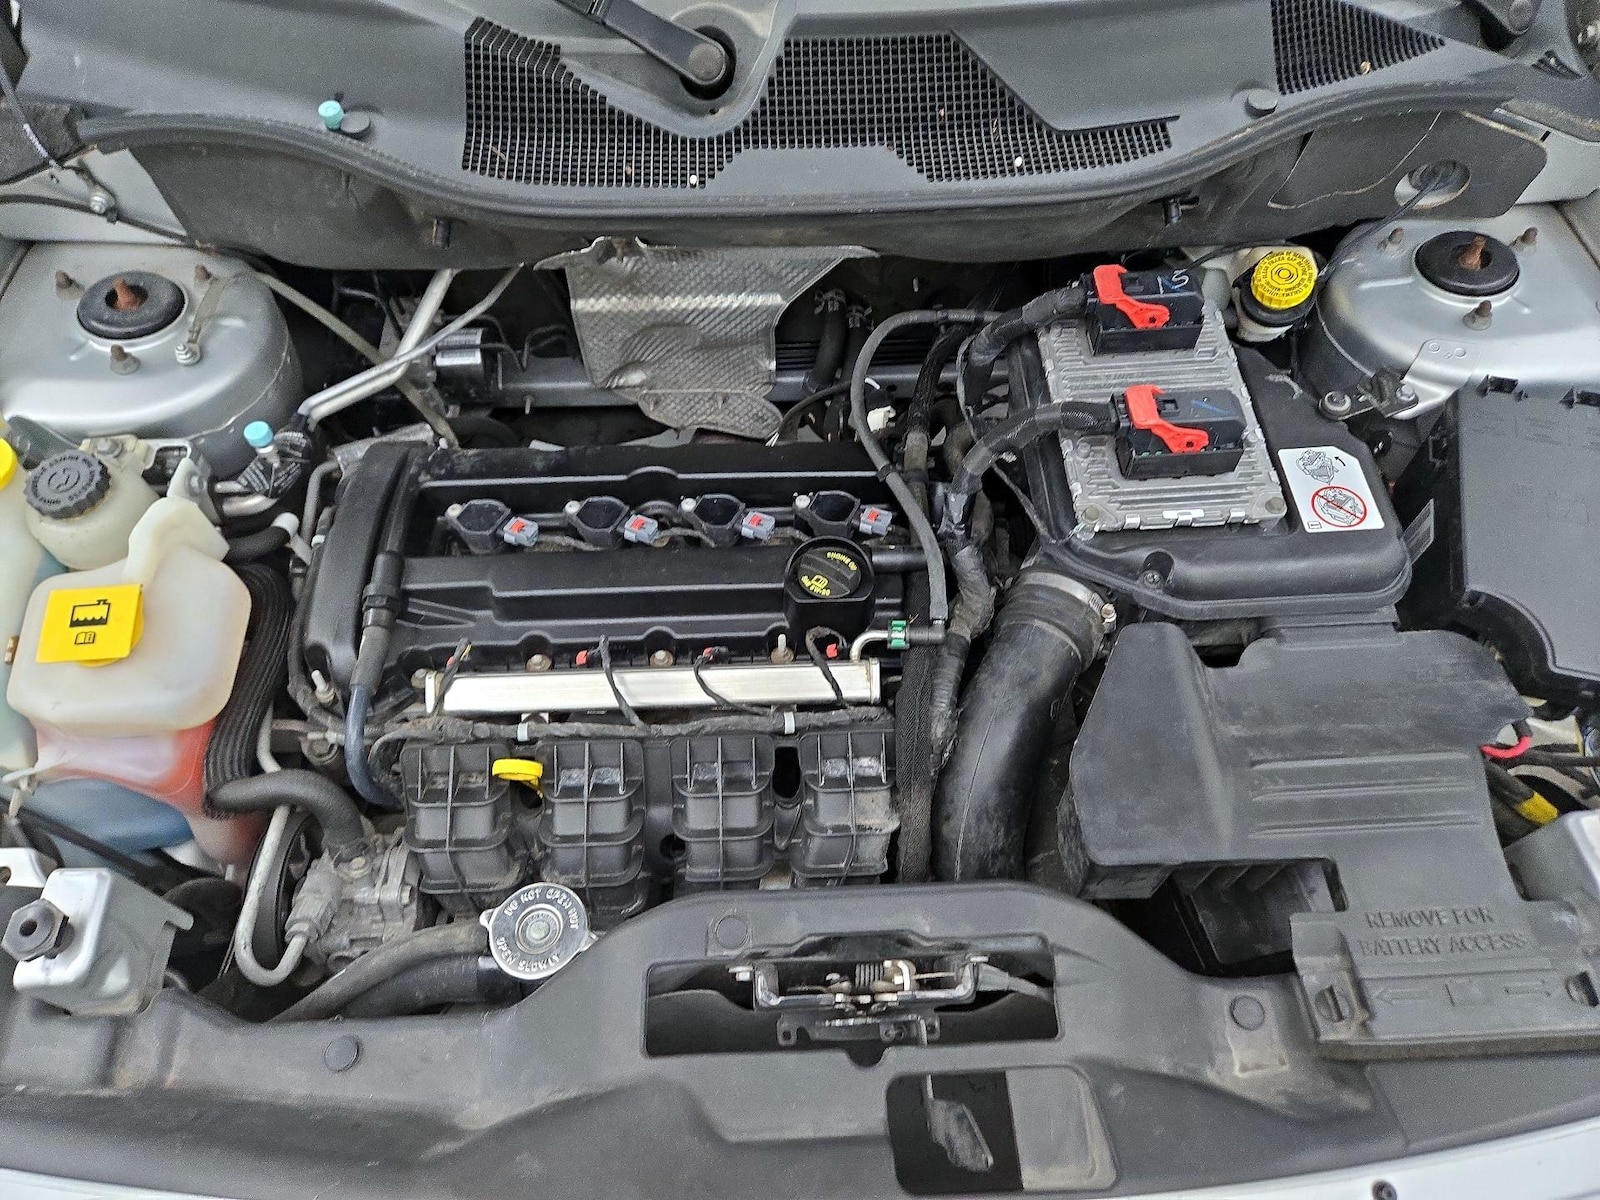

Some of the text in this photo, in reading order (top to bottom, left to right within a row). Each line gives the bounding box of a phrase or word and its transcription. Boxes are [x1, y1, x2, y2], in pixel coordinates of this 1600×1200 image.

[504, 900, 519, 917] DO
[520, 888, 542, 904] NOT
[546, 888, 572, 909] OPEN
[1364, 906, 1495, 929] REMOVE FOR
[496, 936, 517, 965] OPEN
[517, 953, 560, 972] SLOWLY
[1359, 932, 1527, 956] BATTERY ACCESS
